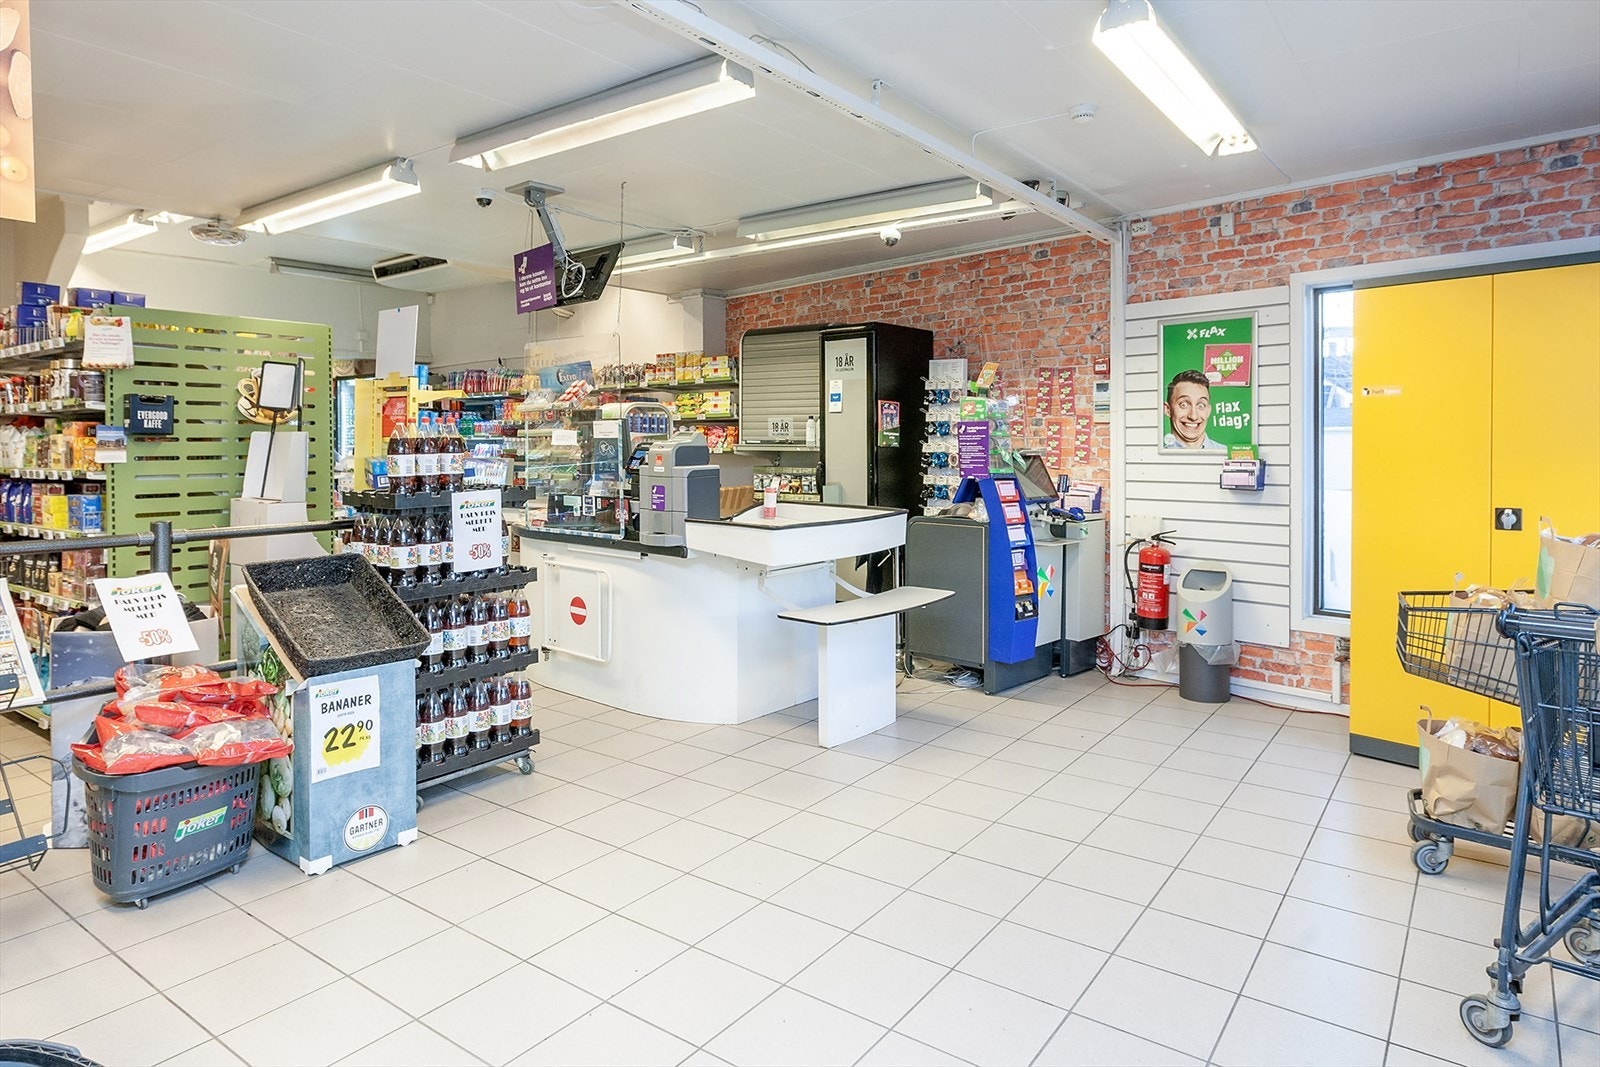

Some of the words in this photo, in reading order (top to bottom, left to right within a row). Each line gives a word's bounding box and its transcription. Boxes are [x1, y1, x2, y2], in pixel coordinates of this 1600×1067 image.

[1200, 326, 1227, 339] FLAX
[835, 356, 843, 368] 18
[844, 352, 855, 367] ÅR
[1210, 355, 1244, 365] MILLION
[1216, 363, 1239, 372] FLAX
[558, 370, 578, 382] Extra
[1215, 401, 1241, 414] Flax
[137, 410, 168, 421] EVERGOOD
[1218, 413, 1251, 429] dag?
[143, 419, 163, 429] KAFFE
[772, 422, 779, 432] 18
[780, 419, 789, 432] ÅR
[468, 542, 492, 560] -50%
[138, 628, 173, 647] -50%
[321, 694, 373, 715] BANANER
[323, 723, 357, 753] 22
[357, 719, 374, 733] 90
[175, 812, 224, 842] joker
[349, 818, 384, 836] GARTNER
